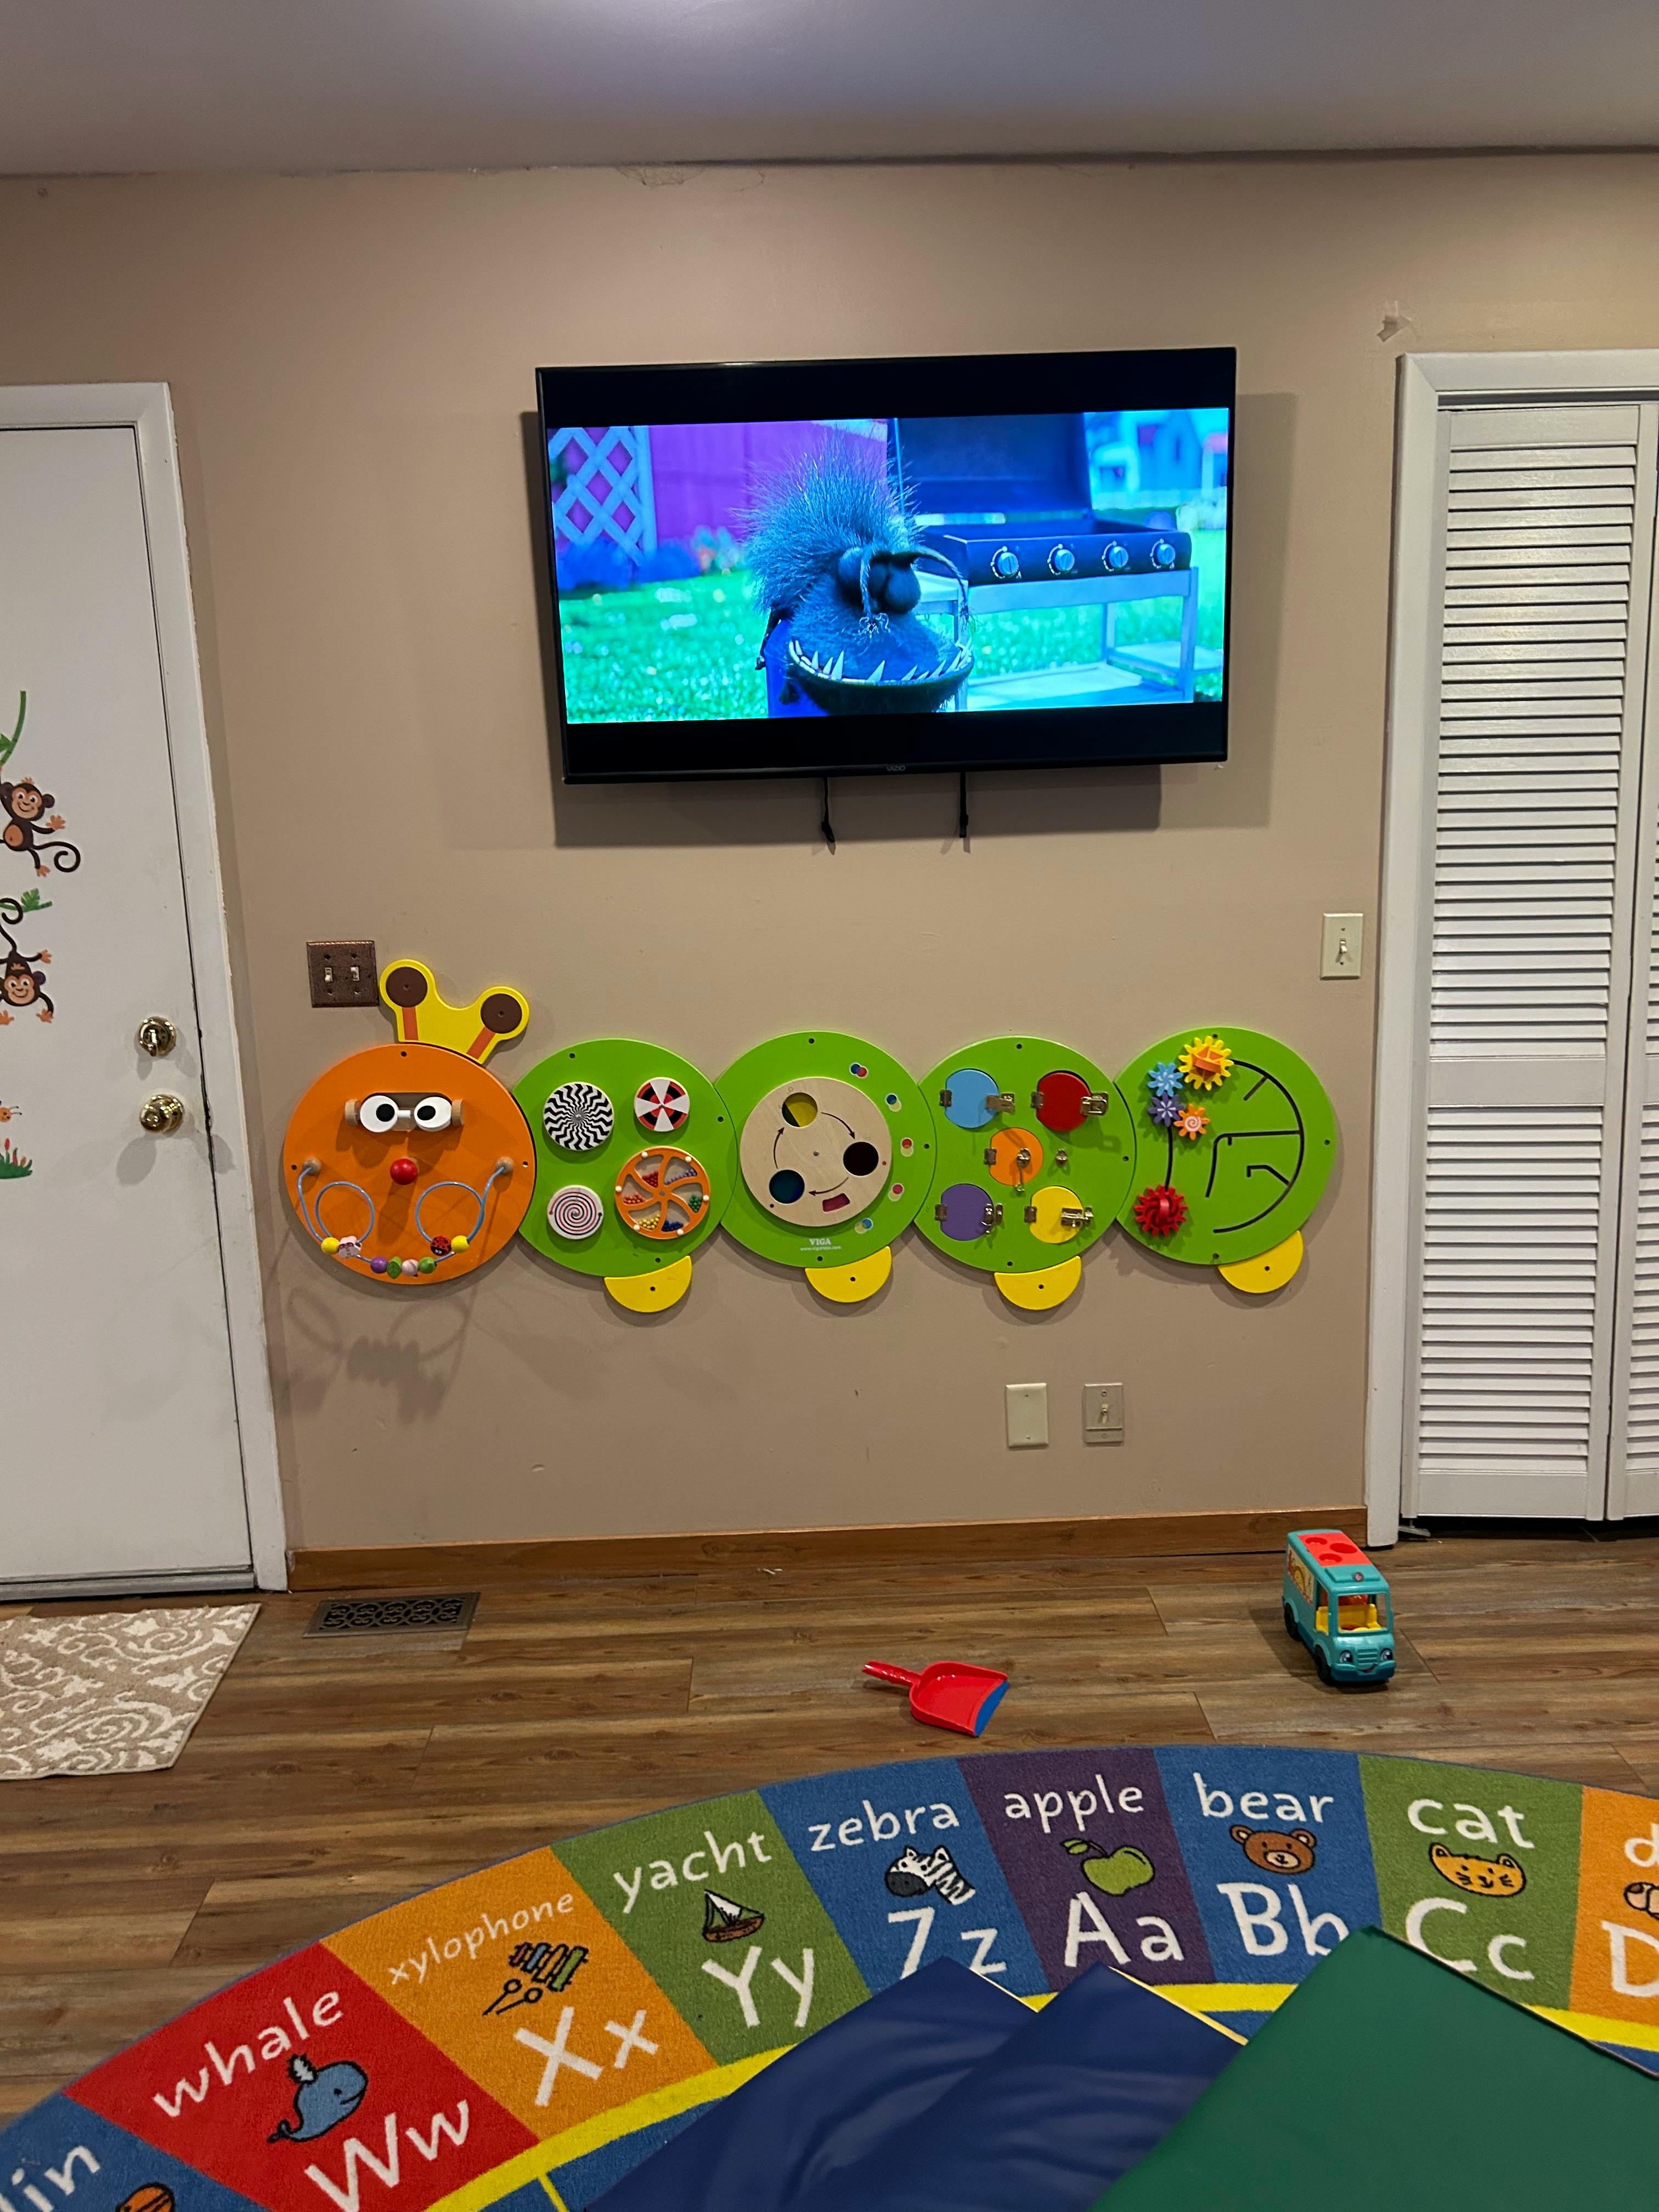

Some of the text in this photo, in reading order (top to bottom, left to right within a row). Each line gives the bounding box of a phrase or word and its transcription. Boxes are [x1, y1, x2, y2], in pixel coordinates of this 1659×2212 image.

[808, 1799, 960, 1851] zebra
[1004, 1774, 1144, 1833] apple
[1193, 1773, 1334, 1823] bear
[1407, 1799, 1534, 1849] cat
[613, 1831, 772, 1914] yacht
[388, 1893, 574, 1985] xylophone
[1064, 1891, 1184, 1967] Aa
[1216, 1882, 1350, 1956] Bb
[1405, 1897, 1534, 1980] Cc
[701, 1945, 814, 2028] Yy
[153, 1991, 343, 2118] whale
[513, 2006, 659, 2107] Xx
[303, 2100, 470, 2212] Ww
